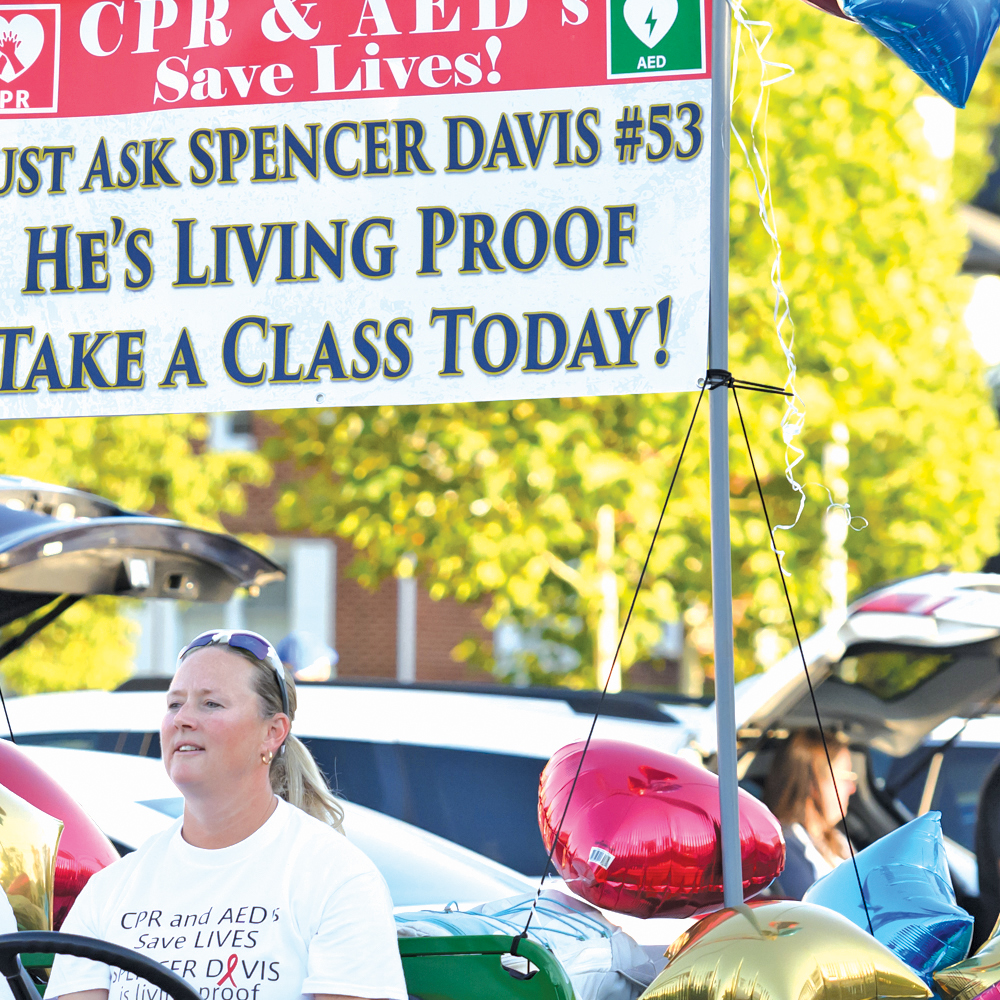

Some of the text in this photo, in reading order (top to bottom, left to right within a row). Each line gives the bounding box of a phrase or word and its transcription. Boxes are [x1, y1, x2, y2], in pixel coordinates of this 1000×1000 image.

[79, 0, 233, 57] CPR
[260, 0, 322, 43] &
[153, 34, 503, 105] Save Lives!
[636, 55, 668, 71] AED
[187, 117, 436, 185] SPENCER
[442, 106, 602, 173] DAVIS
[614, 100, 703, 164] #53
[157, 326, 208, 389] A
[120, 909, 163, 930] CPR
[169, 906, 213, 929] and
[133, 929, 259, 950] Save LIVES
[206, 956, 281, 983] DVIS
